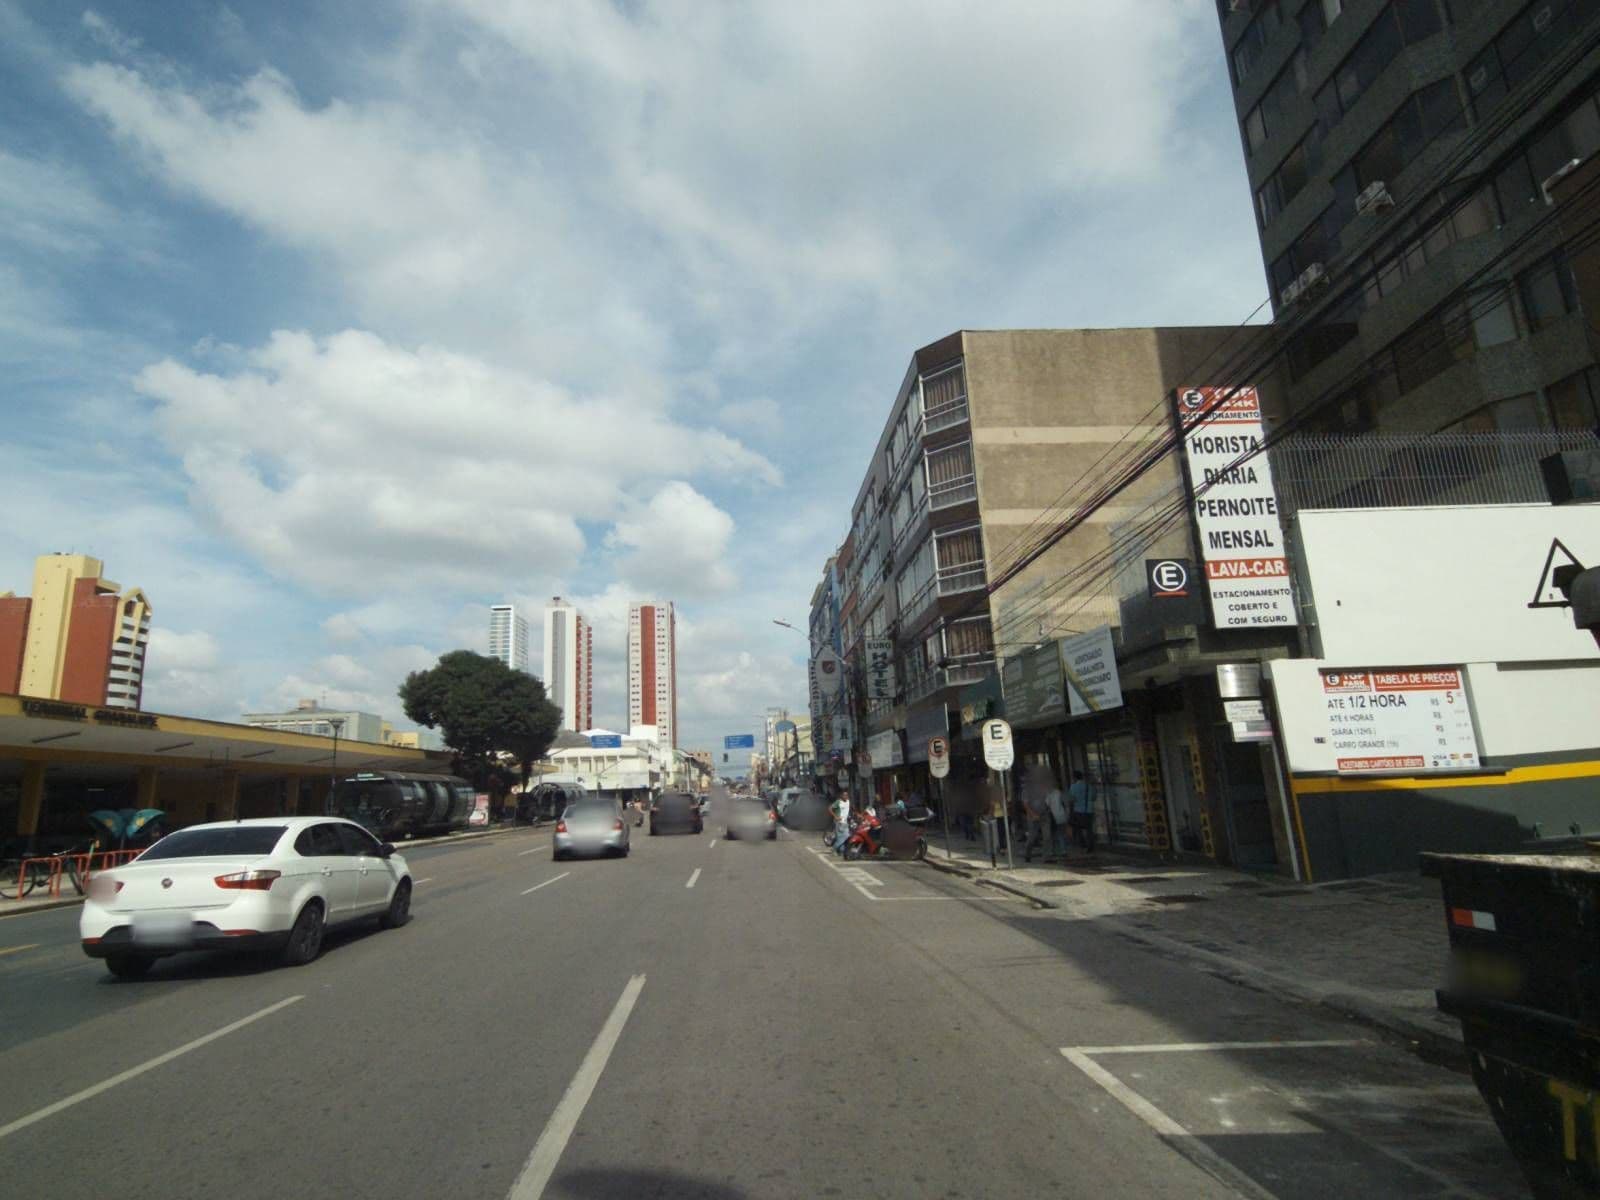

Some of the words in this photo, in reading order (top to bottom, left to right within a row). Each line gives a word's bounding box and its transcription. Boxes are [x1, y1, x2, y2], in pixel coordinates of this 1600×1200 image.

[1192, 435, 1259, 455] HORISTA
[1197, 497, 1277, 518] PERNOITE
[1208, 529, 1274, 550] MENSAL
[1160, 566, 1179, 586] E
[1209, 560, 1286, 577] LAVA-CAR
[1213, 588, 1291, 600] ESTACIONAMENTO
[1228, 602, 1270, 612] COBERTO
[1272, 602, 1278, 610] E
[1228, 616, 1248, 625] COM
[1252, 615, 1288, 624] SEGURO
[1375, 675, 1408, 685] TABELA
[1410, 674, 1422, 684] DE
[1423, 672, 1457, 685] PREÇOS
[1348, 695, 1366, 709] 1/2
[1369, 694, 1407, 709] HORA
[1445, 691, 1454, 704] 5
[990, 723, 1004, 740] E
